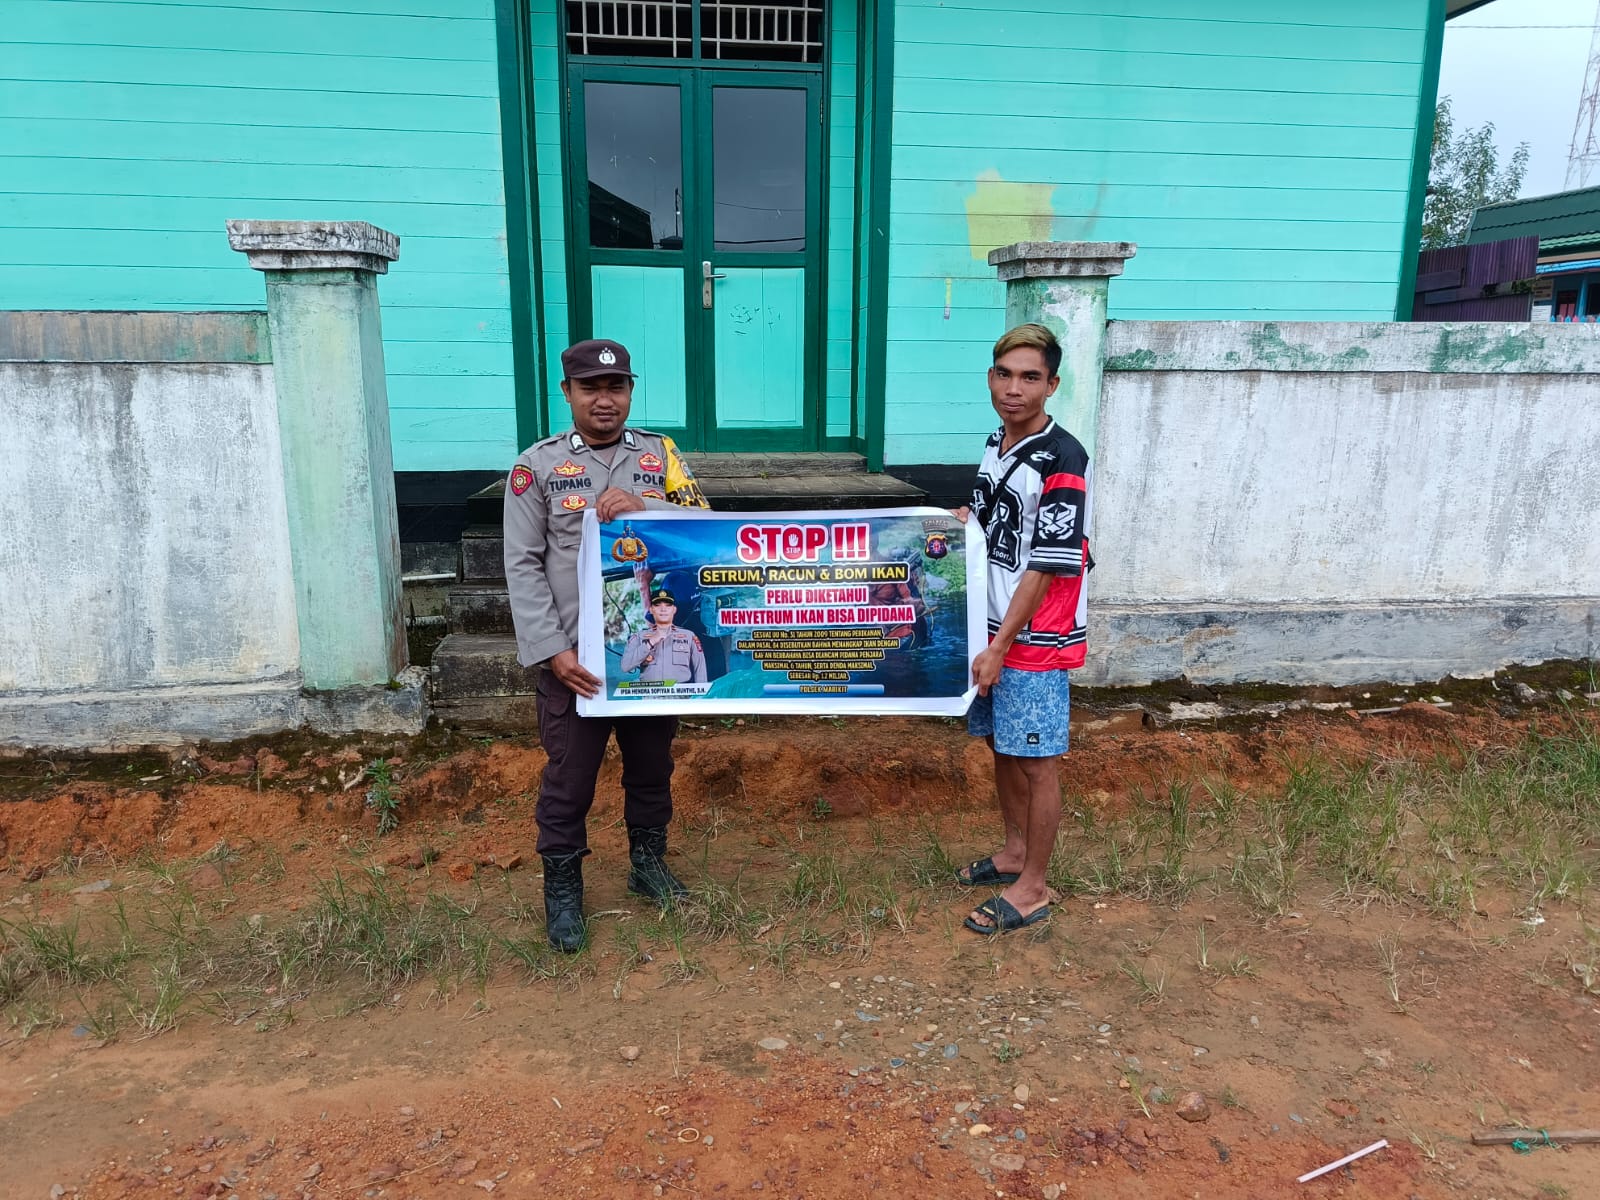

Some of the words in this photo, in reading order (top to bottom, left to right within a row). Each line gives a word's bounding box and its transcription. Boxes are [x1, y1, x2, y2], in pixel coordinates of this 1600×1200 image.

[549, 478, 592, 492] TUPANG
[633, 473, 666, 486] POLR
[739, 527, 826, 561] STOP
[834, 526, 867, 559] !!!
[703, 570, 764, 583] SETRUM,
[769, 569, 815, 581] RACUN
[820, 568, 830, 581] &
[835, 567, 867, 580] BOM
[872, 567, 905, 579] IKAN
[767, 590, 803, 604] PERLU
[805, 588, 867, 604] DIKETAHUI
[721, 609, 793, 625] MENYETRUM
[796, 609, 824, 624] IKAN
[827, 608, 855, 623] BISA
[857, 607, 914, 622] DIPIDANA
[814, 630, 828, 638] 2009
[831, 640, 863, 648] MENANGKAP
[802, 651, 815, 659] BISA
[859, 650, 883, 658] PENJARA
